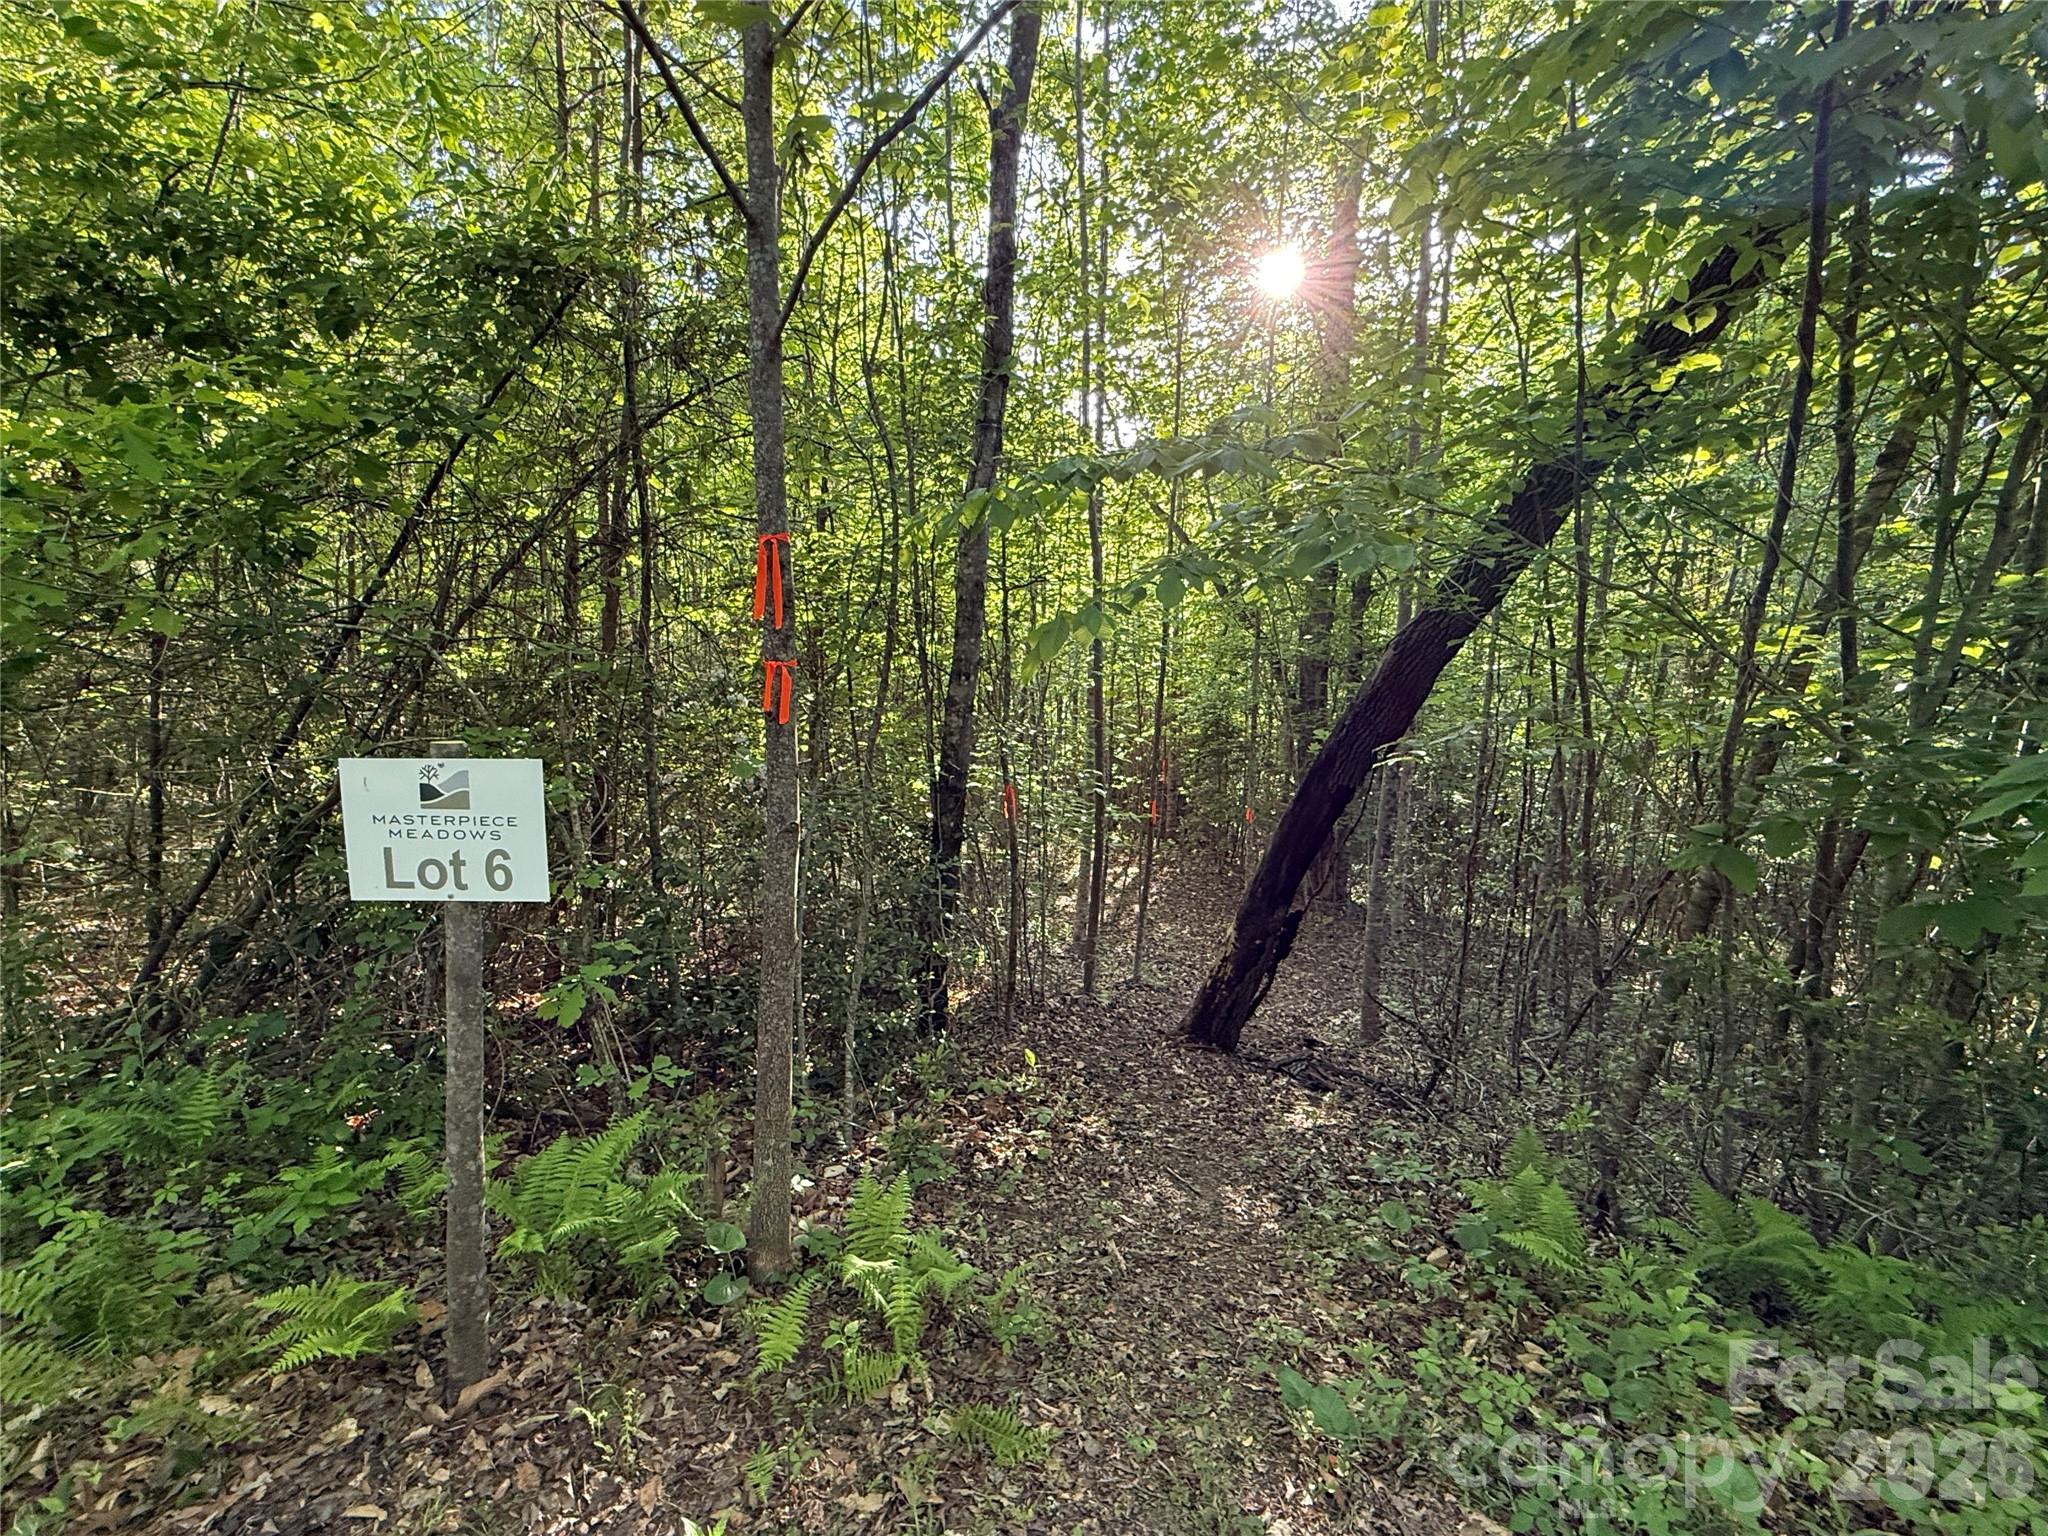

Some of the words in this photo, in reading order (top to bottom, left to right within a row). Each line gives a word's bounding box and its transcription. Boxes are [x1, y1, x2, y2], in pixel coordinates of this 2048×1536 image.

[372, 814, 518, 827] MASTERPIECE
[389, 828, 502, 841] MEADOWS
[383, 846, 469, 891] Lot
[485, 848, 514, 892] 6
